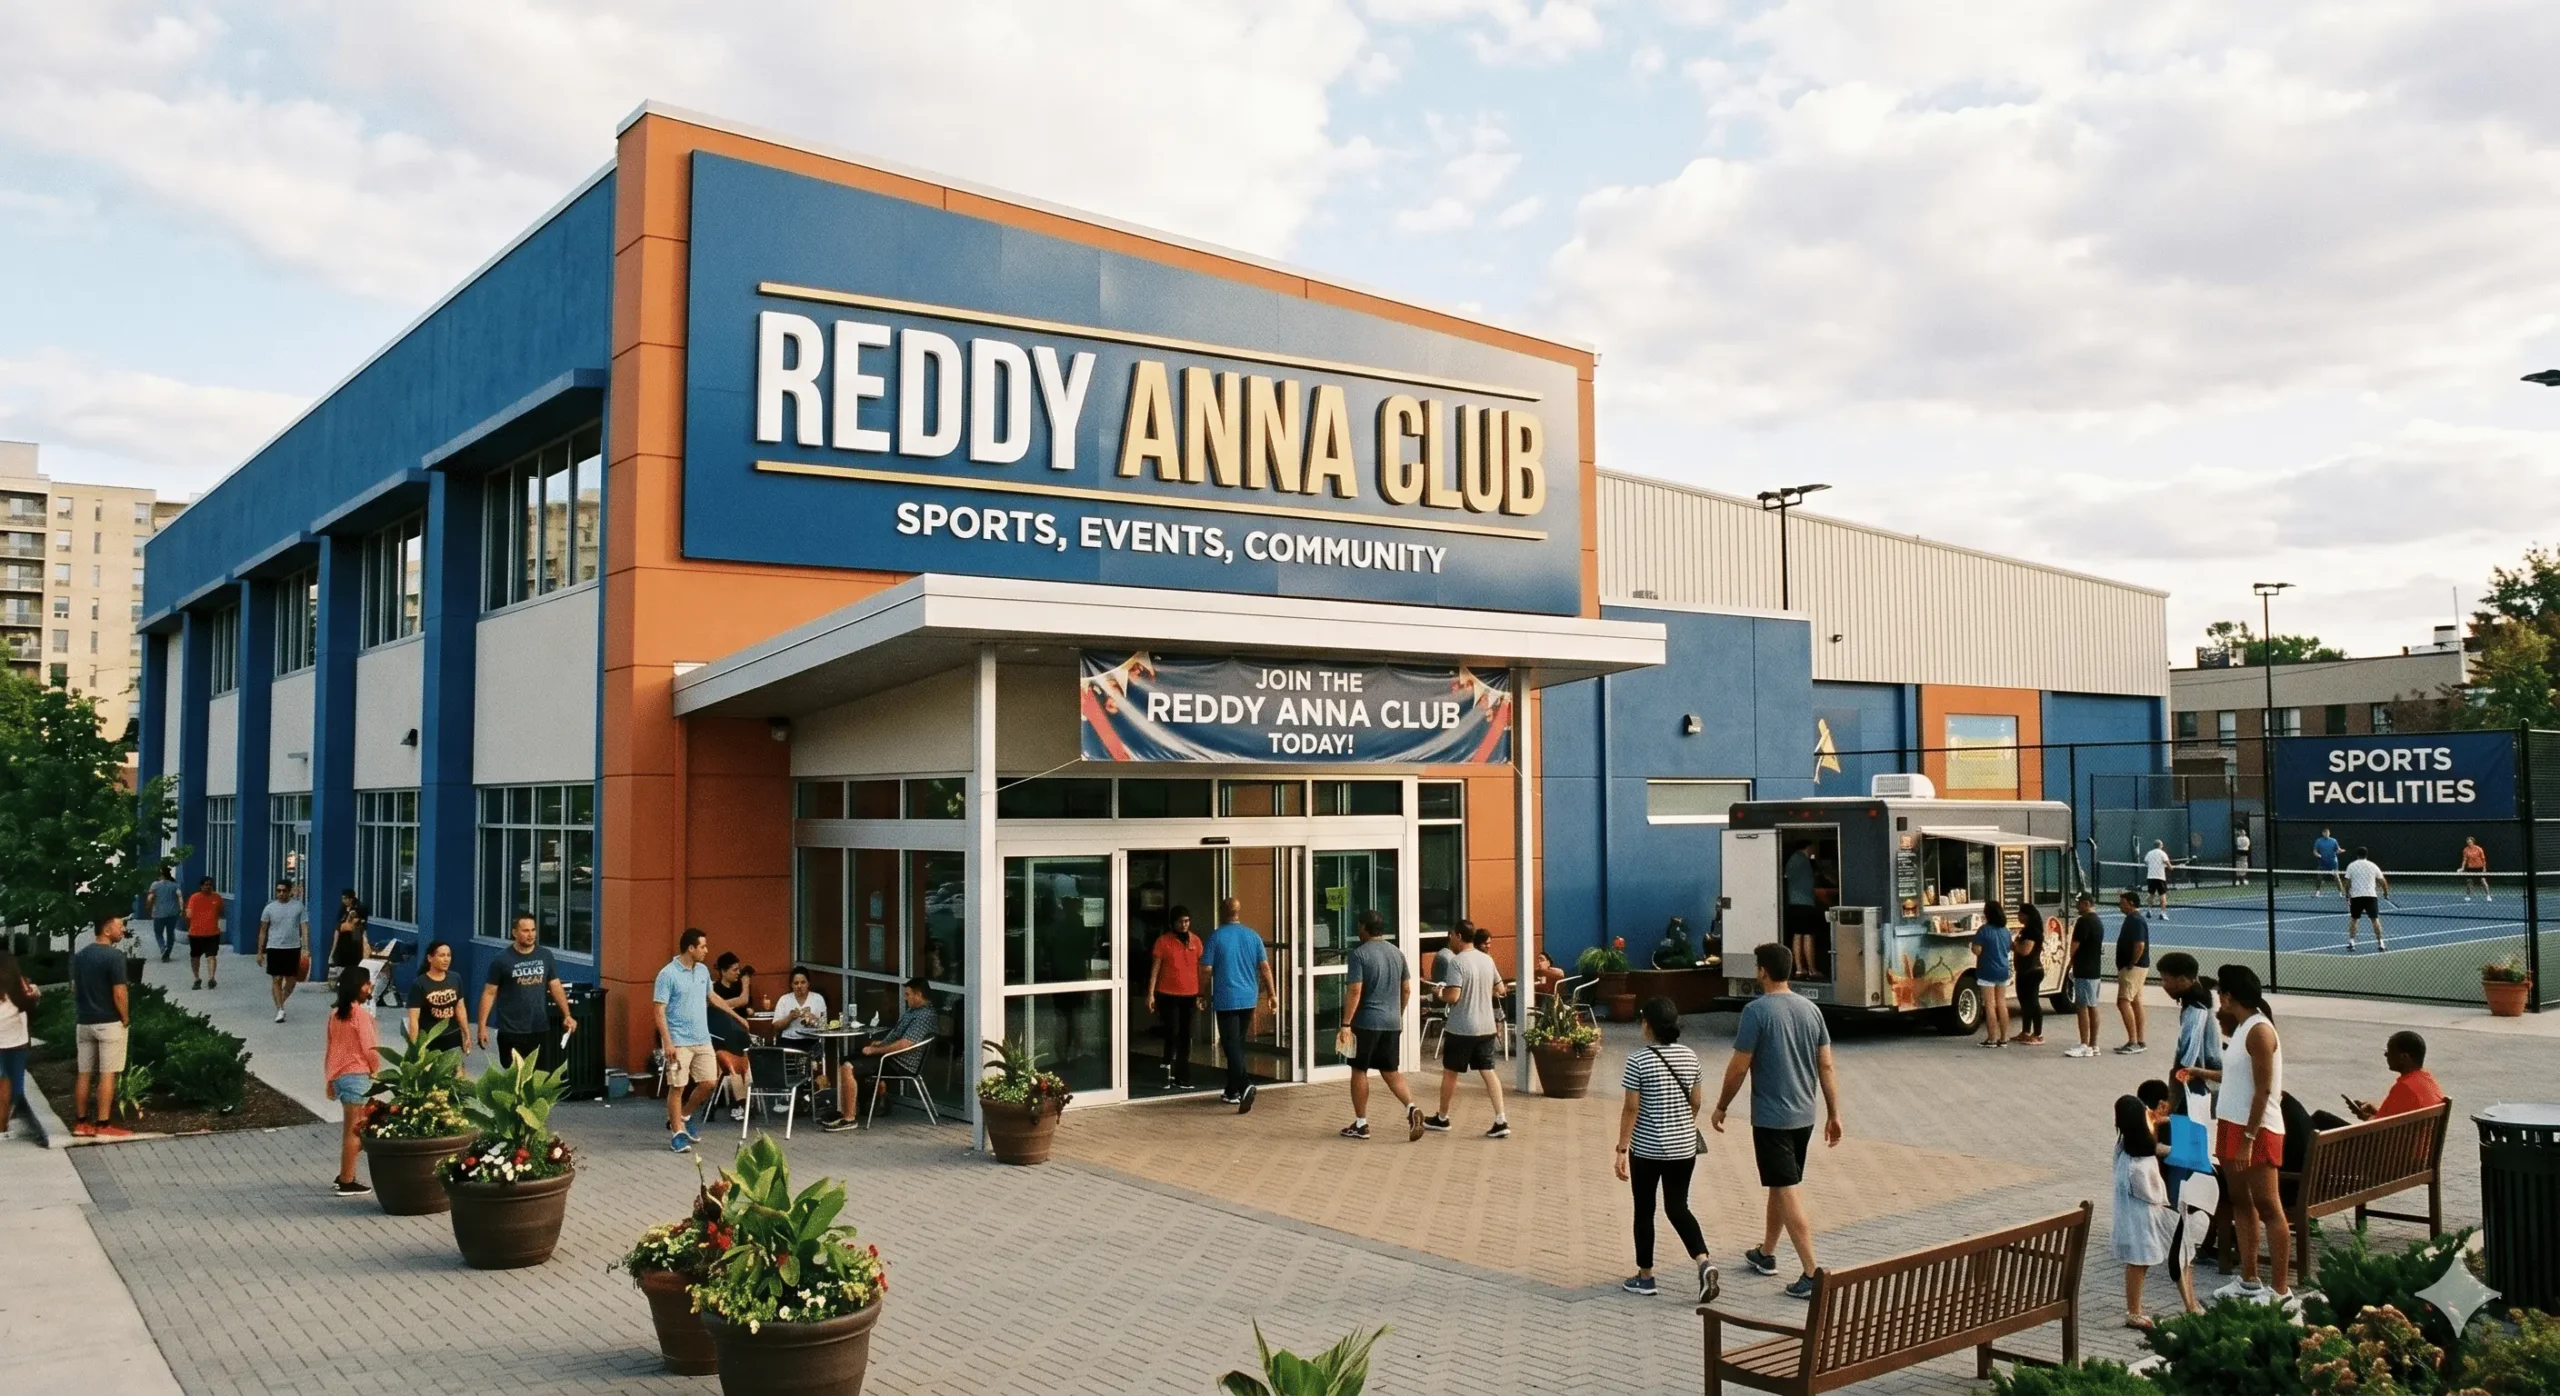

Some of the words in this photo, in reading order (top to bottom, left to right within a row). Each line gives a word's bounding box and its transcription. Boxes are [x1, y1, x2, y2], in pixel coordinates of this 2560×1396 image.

[757, 310, 1096, 471] REDDY
[1119, 360, 1359, 499] ANNA
[1378, 394, 1547, 516] CLUB
[896, 502, 1068, 554] SPORTS,
[1079, 518, 1234, 564] EVENTS,
[1244, 531, 1447, 575] COMMUNITY
[1255, 669, 1311, 692] JOIN
[1319, 671, 1364, 693] THE
[1147, 692, 1266, 725] REDDY
[1276, 698, 1372, 728] ANNA
[1380, 701, 1461, 730] CLUB
[1268, 732, 1355, 755] TODAY!
[2328, 747, 2453, 773] SPORTS
[2308, 779, 2477, 804] FACILITIES
